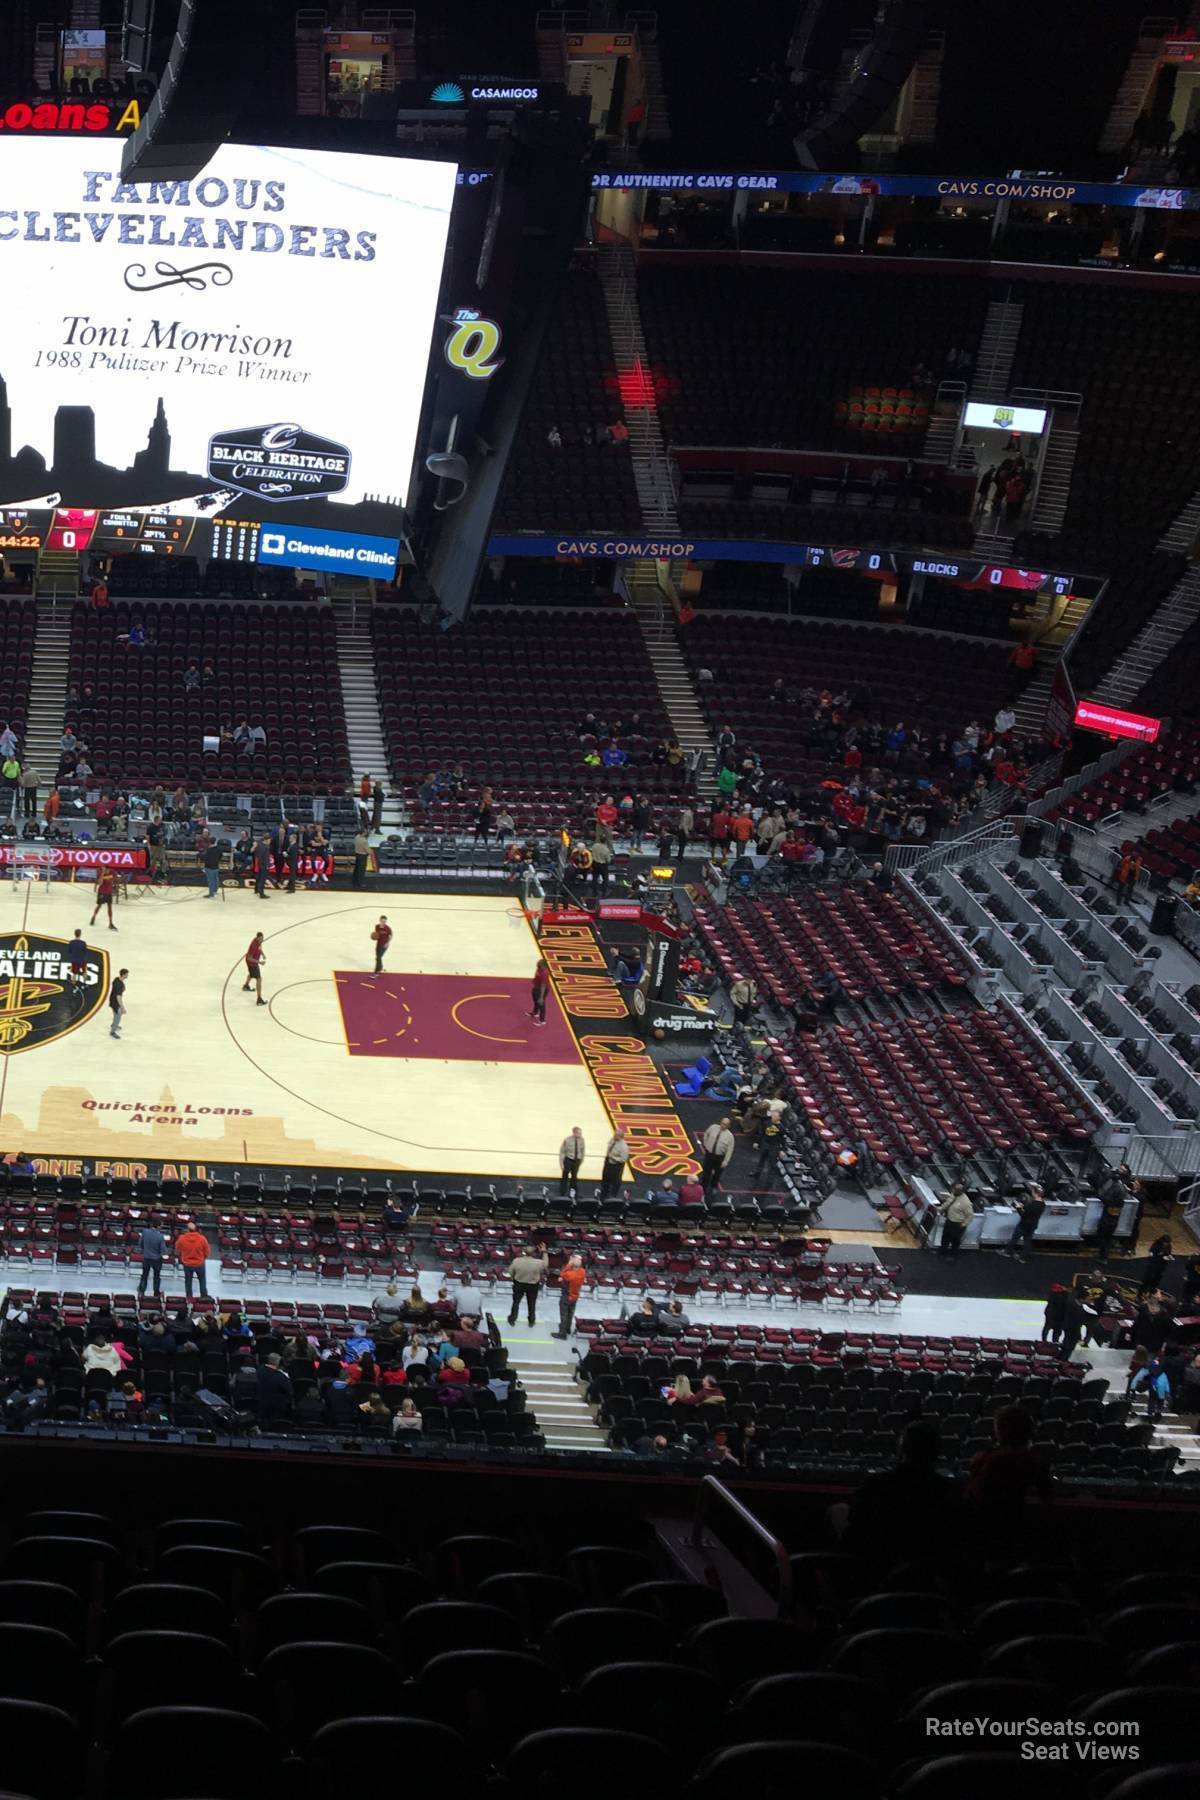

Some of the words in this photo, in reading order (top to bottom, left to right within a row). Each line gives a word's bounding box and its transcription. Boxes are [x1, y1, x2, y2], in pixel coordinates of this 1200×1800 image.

[471, 87, 539, 100] CASAMIGOS
[613, 174, 693, 187] AUTHENTIC
[697, 175, 734, 188] CAVS
[737, 176, 778, 189] GEAR
[82, 170, 286, 213] FAMOUS
[937, 180, 1076, 200] CAVS.COM/SHOP
[454, 309, 479, 321] The
[62, 316, 132, 347] Toni
[140, 319, 293, 358] Morrison
[444, 319, 499, 379] Q
[33, 350, 82, 368] 1988
[88, 351, 169, 372] Pulitzer
[175, 356, 229, 377] Prize
[238, 361, 312, 384] Winner
[212, 446, 265, 463] BLACK
[268, 452, 346, 471] HERITAGE
[175, 518, 182, 526] 0
[62, 531, 76, 547] 0
[116, 528, 124, 536] 0
[172, 531, 179, 539] 0
[287, 540, 354, 559] Cleveland
[356, 549, 396, 566] Clinic
[557, 541, 695, 557] CAVS.COM/SHOP
[812, 556, 820, 565] 0
[869, 554, 880, 570] 0
[913, 560, 959, 576] BLOCKS
[990, 569, 1002, 585] 0
[1055, 583, 1064, 594] 0
[65, 850, 134, 865] TOYOTA
[653, 1017, 682, 1031] drug
[683, 1019, 714, 1030] mart
[81, 1099, 177, 1113] Quicken
[184, 1104, 254, 1116] Loans
[579, 1034, 704, 1176] CAVALIERS
[129, 1113, 199, 1125] Arena
[31, 1158, 83, 1178] ONE
[95, 1160, 148, 1179] FOR
[161, 1163, 209, 1182] ALL
